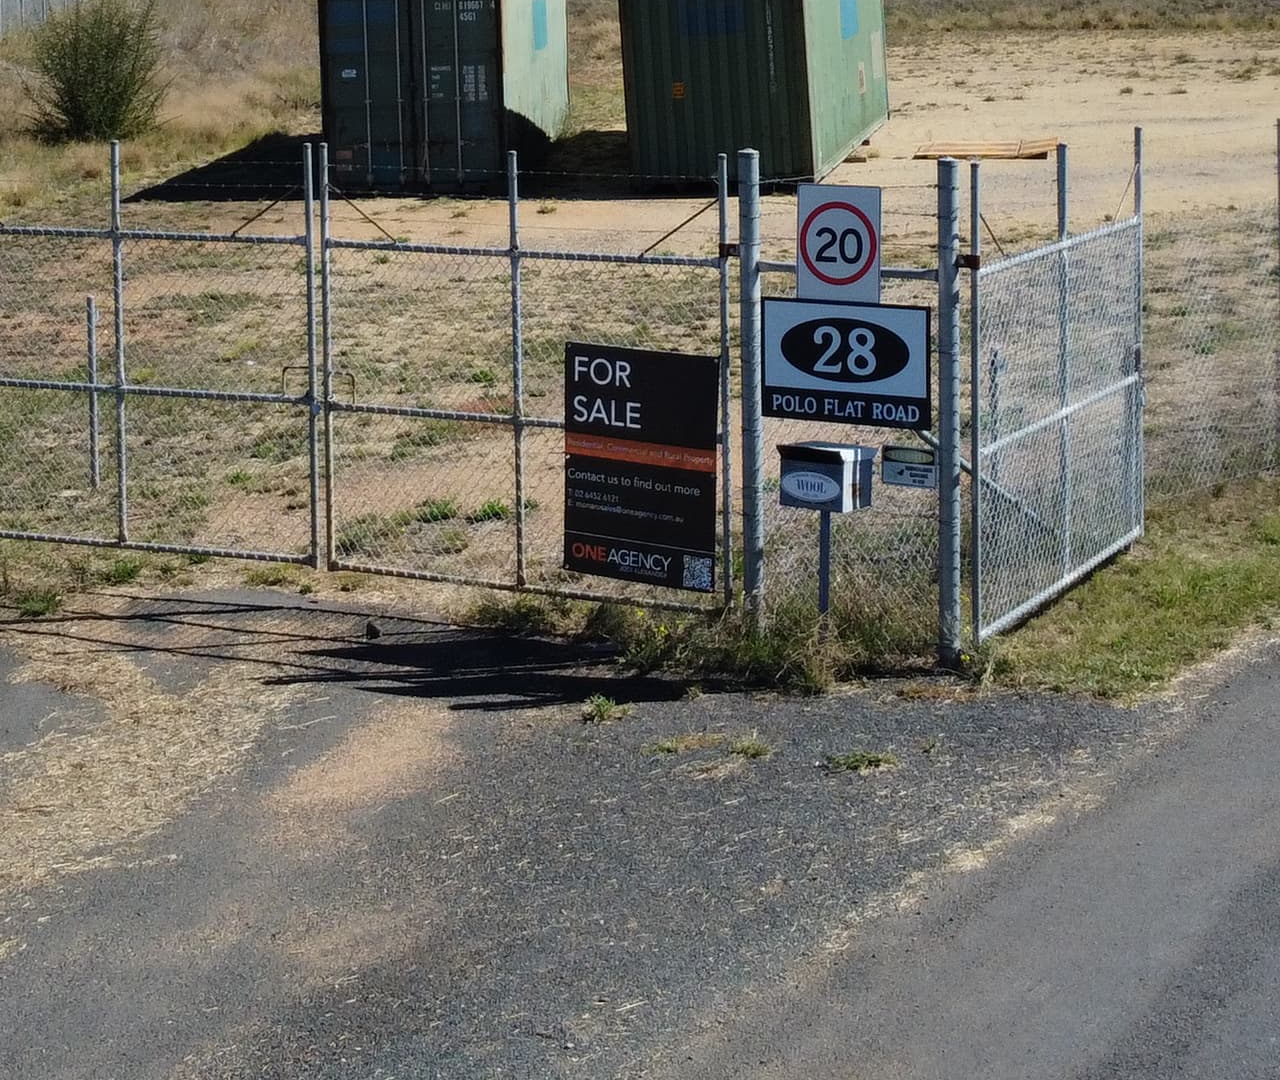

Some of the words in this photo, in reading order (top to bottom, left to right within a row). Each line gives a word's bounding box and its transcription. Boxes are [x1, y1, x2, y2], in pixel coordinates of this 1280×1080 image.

[815, 227, 863, 264] 20
[813, 325, 877, 376] 28
[574, 356, 631, 388] FOR
[573, 395, 642, 429] SALE
[772, 394, 817, 414] POLO
[824, 398, 866, 418] FLAT
[872, 402, 920, 422] ROAD
[567, 468, 605, 483] Contact
[607, 475, 619, 485] us
[621, 476, 631, 487] to
[633, 477, 653, 490] find
[655, 482, 672, 493] out
[674, 485, 701, 497] more
[796, 478, 827, 494] WOOL
